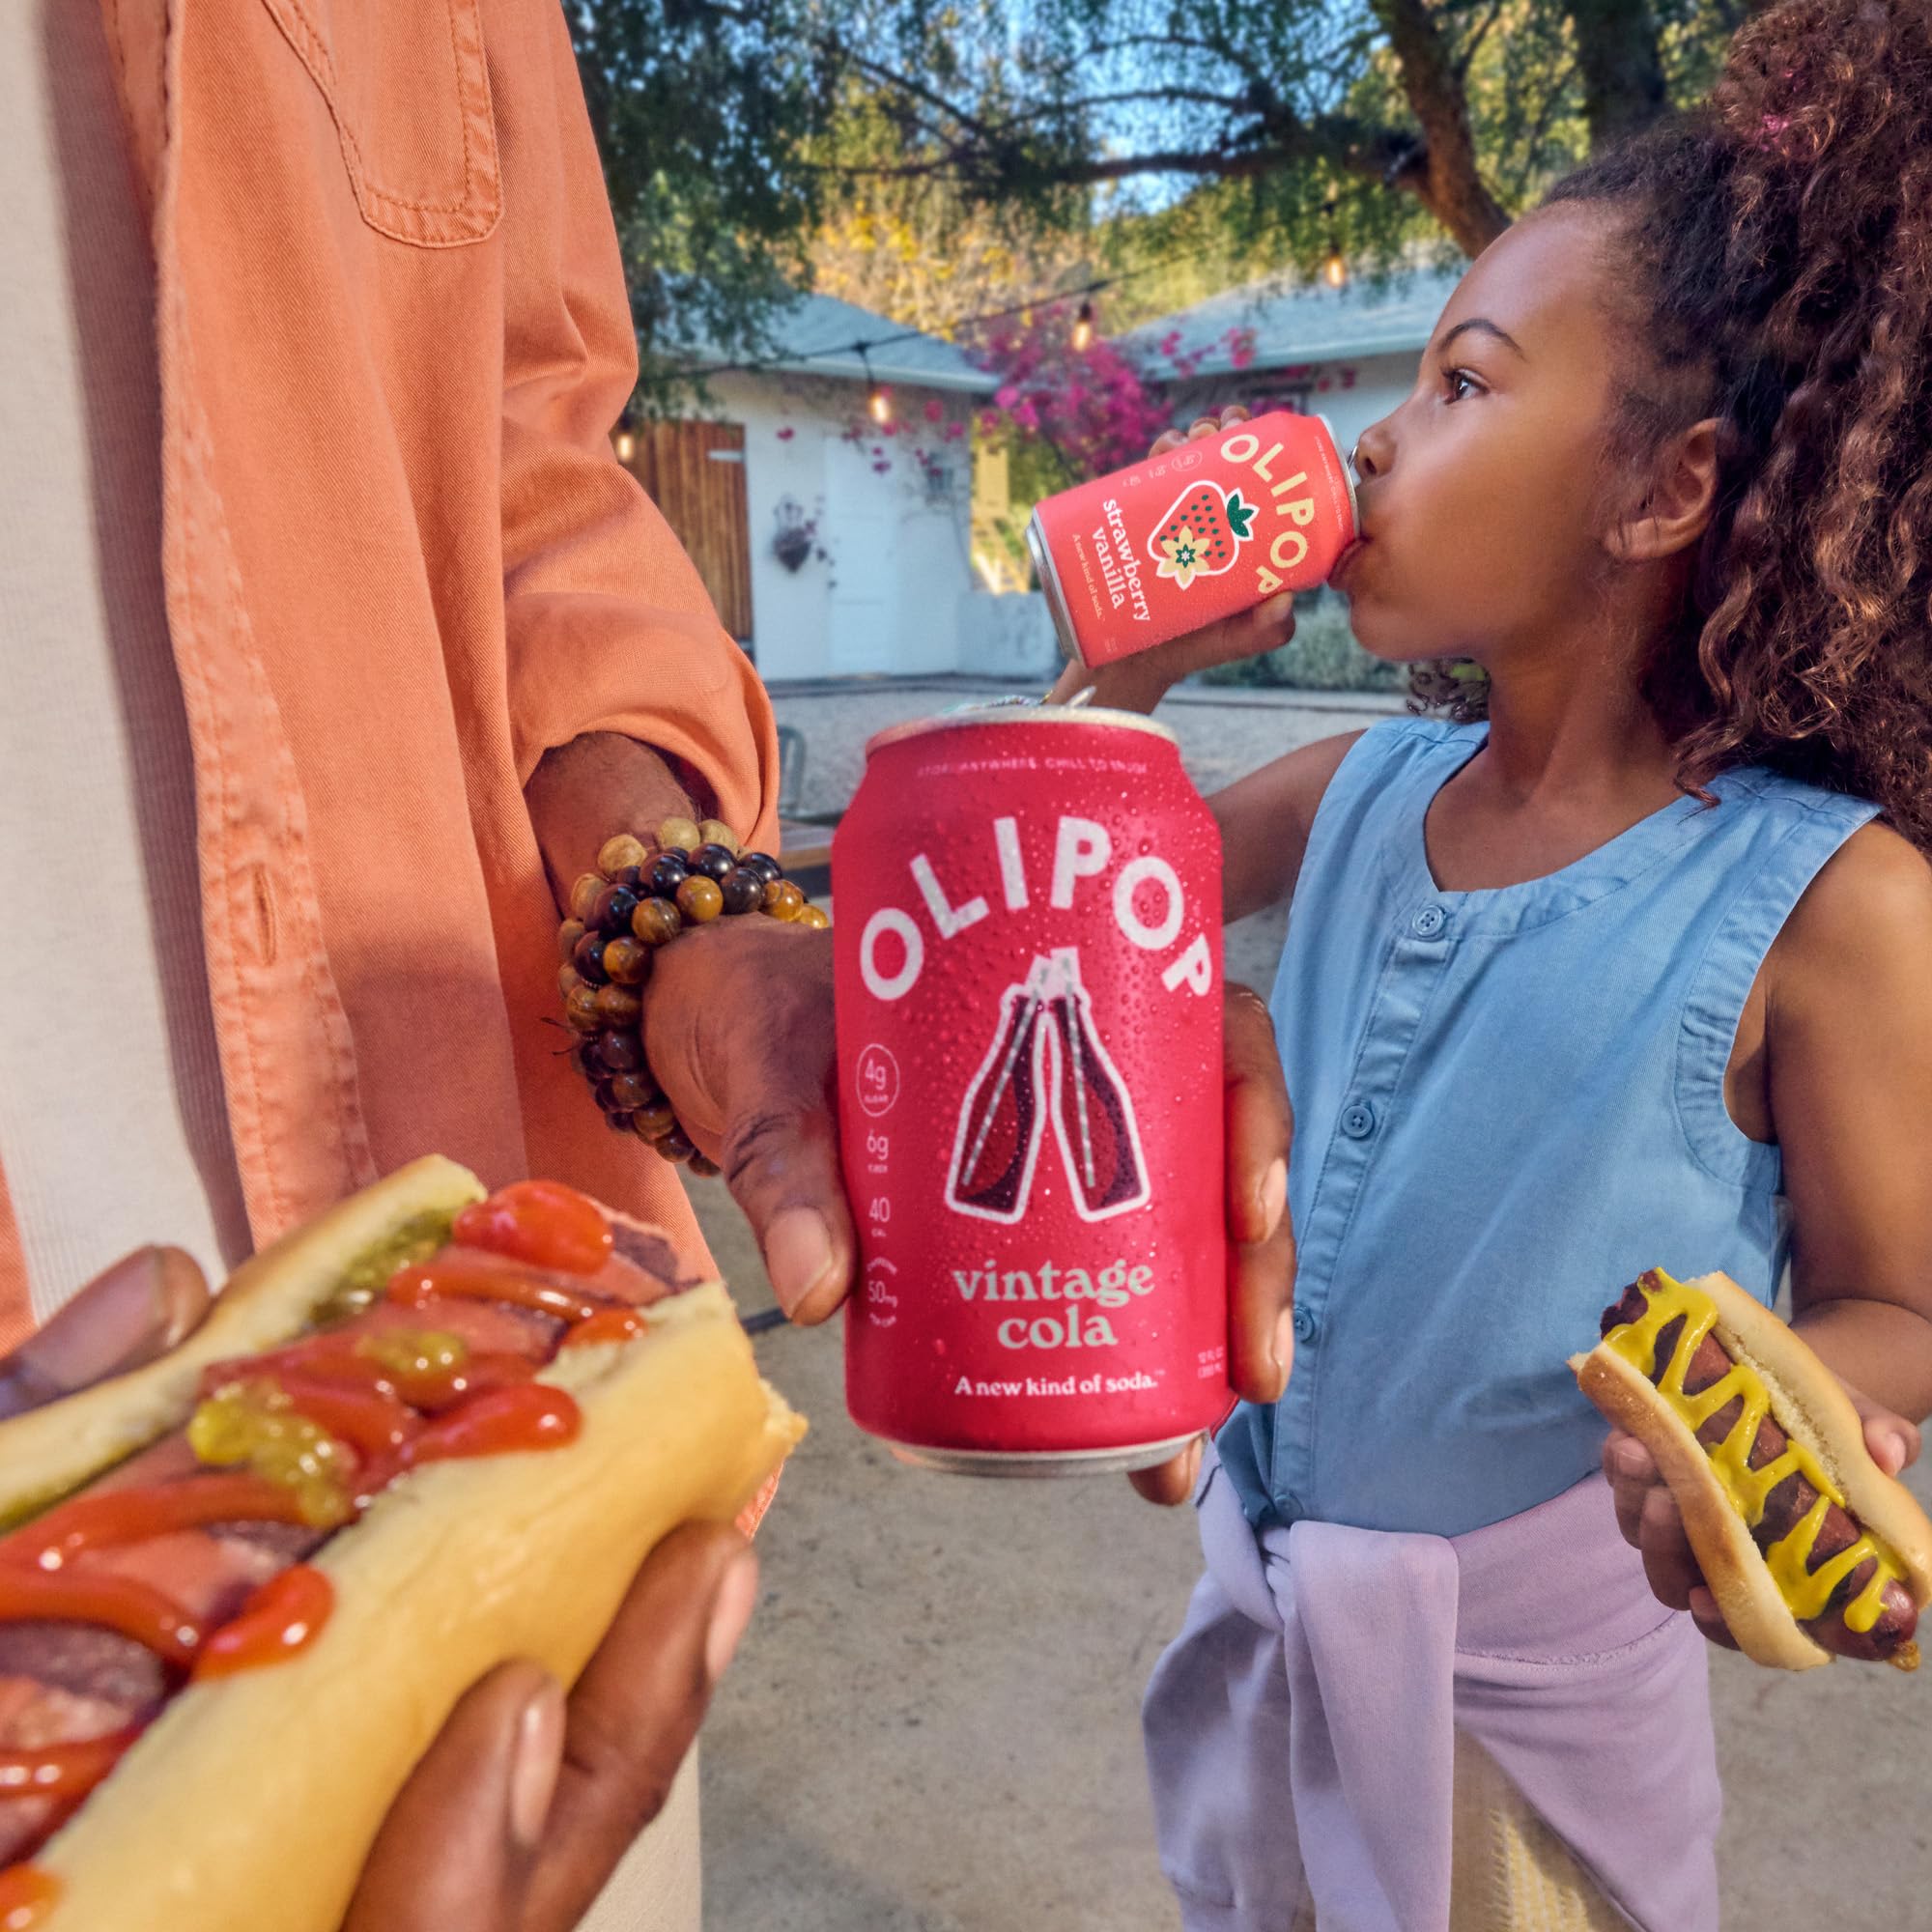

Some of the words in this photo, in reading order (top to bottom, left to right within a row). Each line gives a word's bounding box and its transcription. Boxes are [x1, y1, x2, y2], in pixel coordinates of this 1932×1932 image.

[1221, 435, 1314, 593] OLIPOP
[1075, 542, 1086, 561] new
[1082, 561, 1094, 583] kind
[1089, 584, 1097, 594] of
[1093, 526, 1125, 609] vanilla
[1103, 499, 1150, 620] strawberry
[860, 815, 1212, 1000] OLIPOP
[865, 1058, 887, 1091] 4g
[869, 1197, 891, 1222] 40
[952, 1259, 1155, 1307] vintage
[997, 1304, 1119, 1350] cola
[954, 1376, 972, 1396] A
[976, 1380, 1022, 1397] new
[1026, 1378, 1075, 1397] kind
[1080, 1373, 1102, 1394] of
